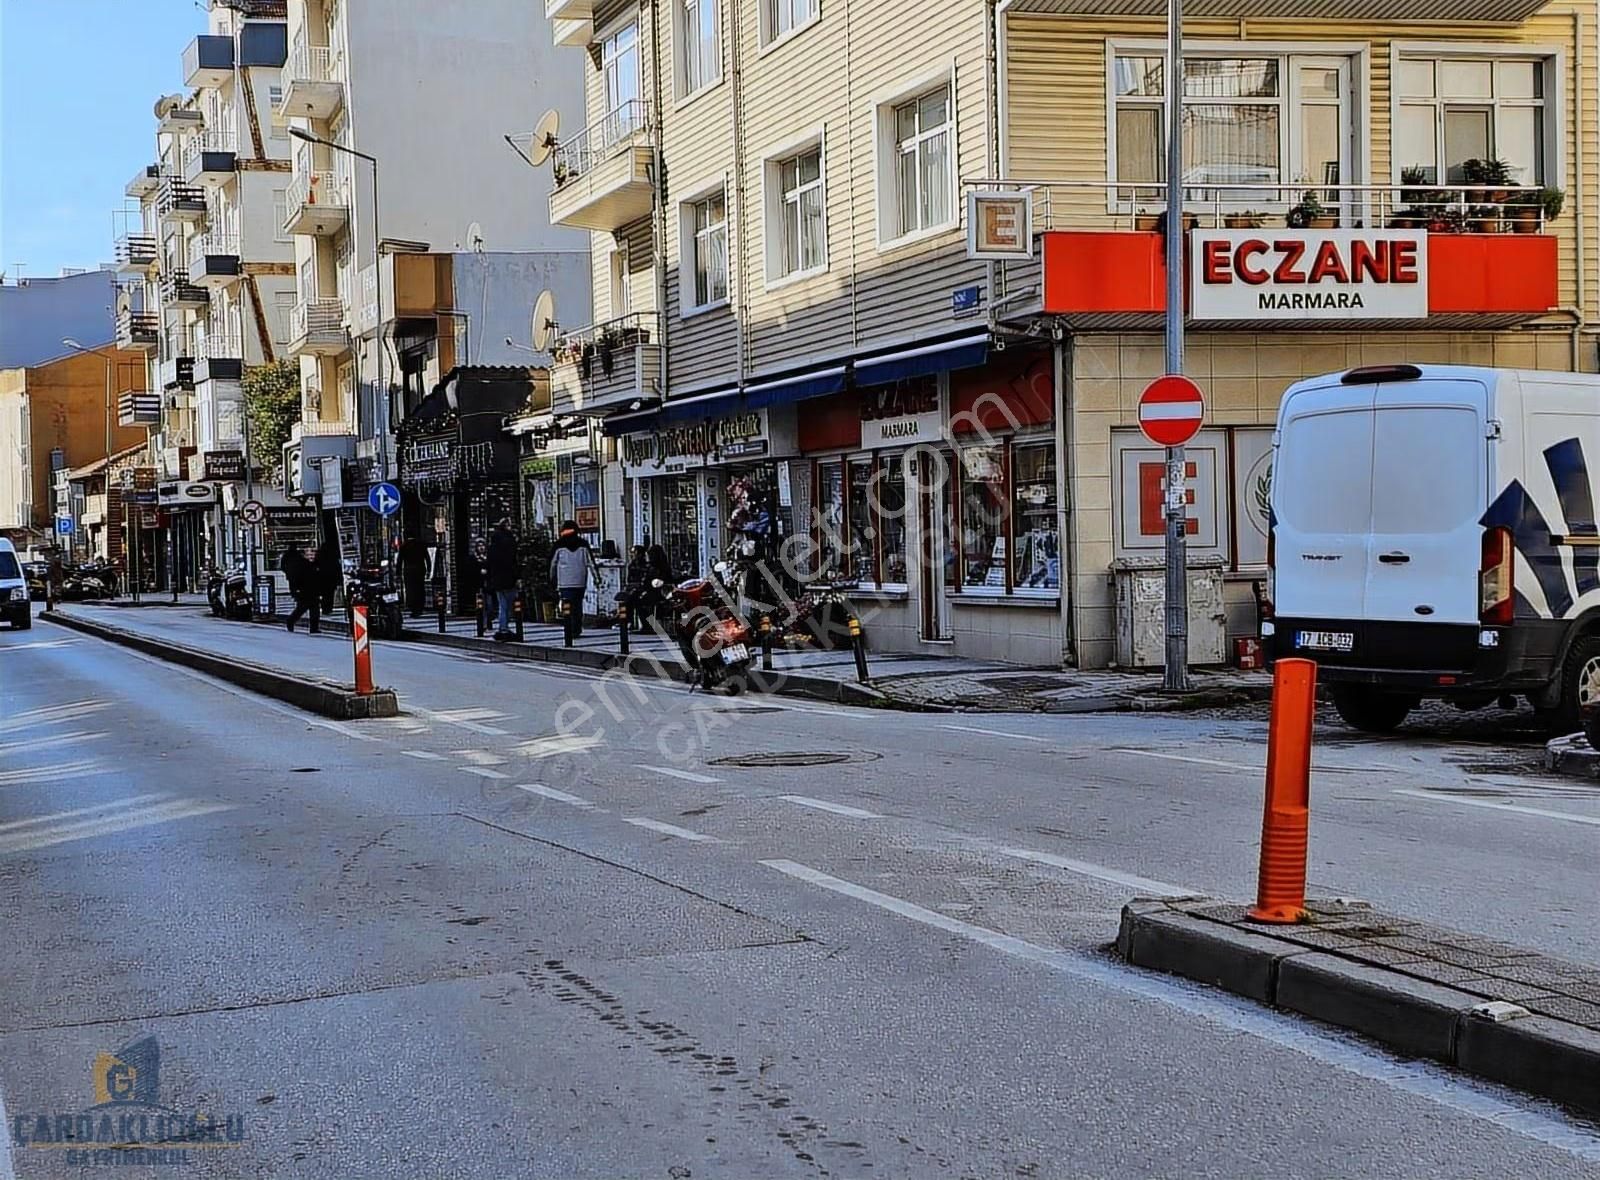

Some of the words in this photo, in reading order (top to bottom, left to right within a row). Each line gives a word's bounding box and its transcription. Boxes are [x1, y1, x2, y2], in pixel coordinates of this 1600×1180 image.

[985, 205, 1017, 245] E
[1202, 239, 1418, 285] ECZANE
[1258, 292, 1364, 310] MARMARA
[881, 420, 919, 439] MARMARA
[641, 479, 650, 549] GÖZLÜ
[1139, 461, 1199, 536] E
[1302, 632, 1312, 645] 17
